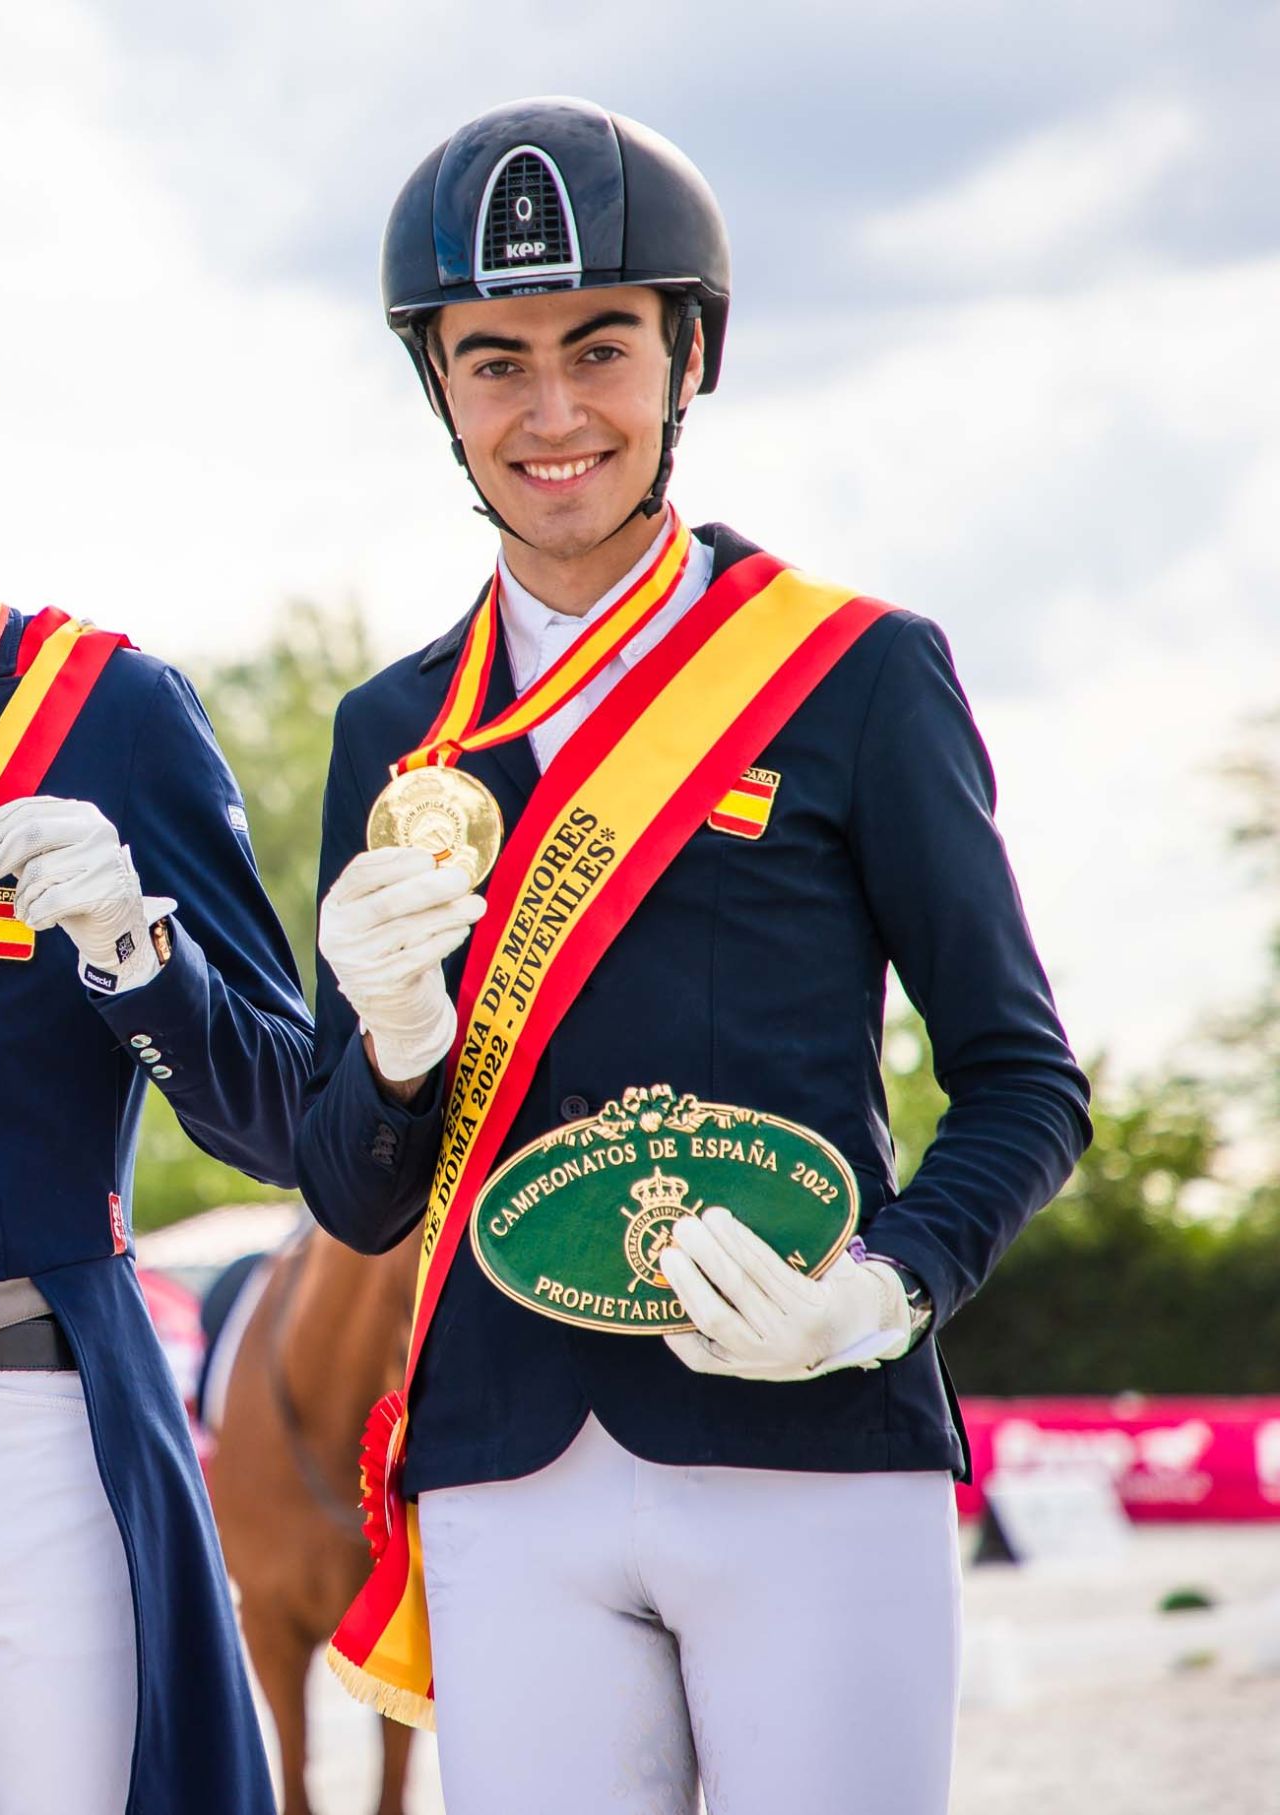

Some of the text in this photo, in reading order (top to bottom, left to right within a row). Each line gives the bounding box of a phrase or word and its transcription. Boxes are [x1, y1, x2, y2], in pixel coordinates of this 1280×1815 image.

[403, 811, 416, 847] RACION
[445, 1020, 491, 1141] ESPAÑA
[481, 965, 511, 1016] DE
[502, 806, 598, 965] MENORES
[425, 1210, 441, 1258] DE
[438, 1115, 478, 1210] DOMA
[471, 1034, 509, 1111] 2022
[489, 1137, 840, 1238] CAMPEONATOS DE ESPAÑA 2022
[628, 1206, 684, 1278] FEDERACION HIPIC
[534, 1275, 687, 1321] PROPIETARIO
